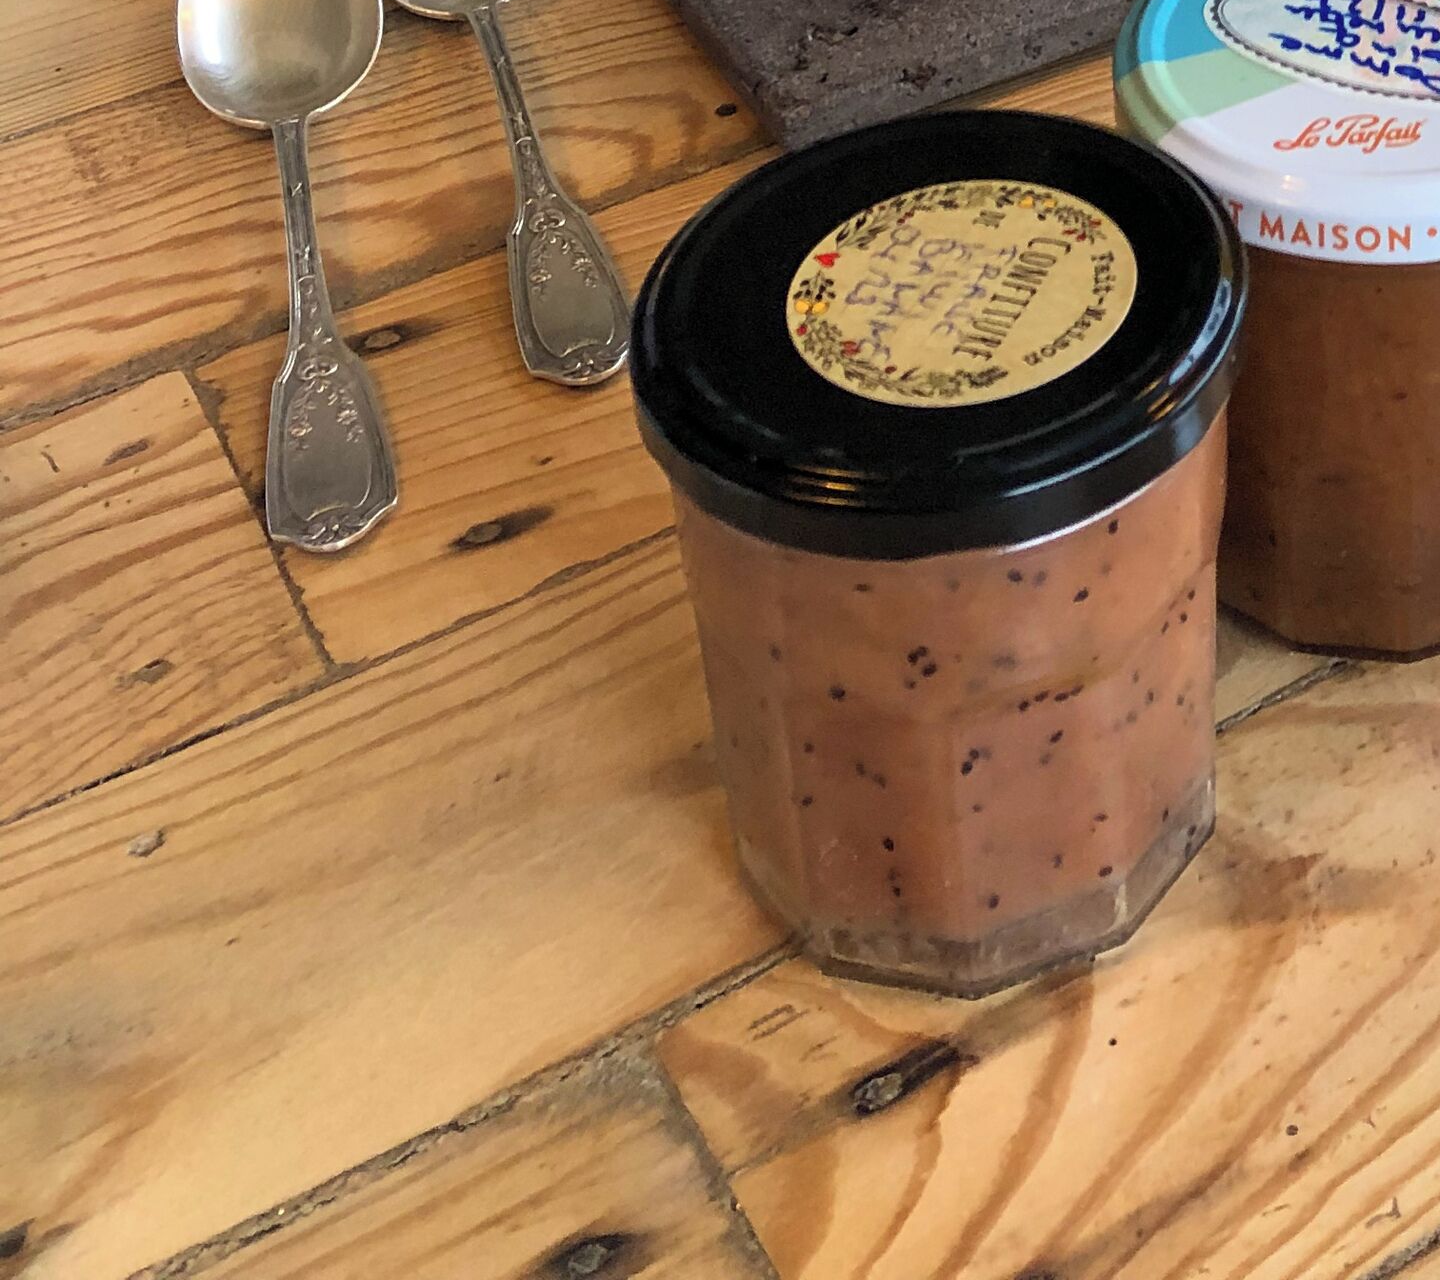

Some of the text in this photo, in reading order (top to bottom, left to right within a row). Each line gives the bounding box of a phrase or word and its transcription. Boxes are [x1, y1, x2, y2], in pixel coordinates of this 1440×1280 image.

[1272, 113, 1428, 154] Le Parfait
[1259, 210, 1412, 253] MAISON
[952, 237, 1071, 361] CONFITURE
[1023, 250, 1116, 366] Fait-Maison
